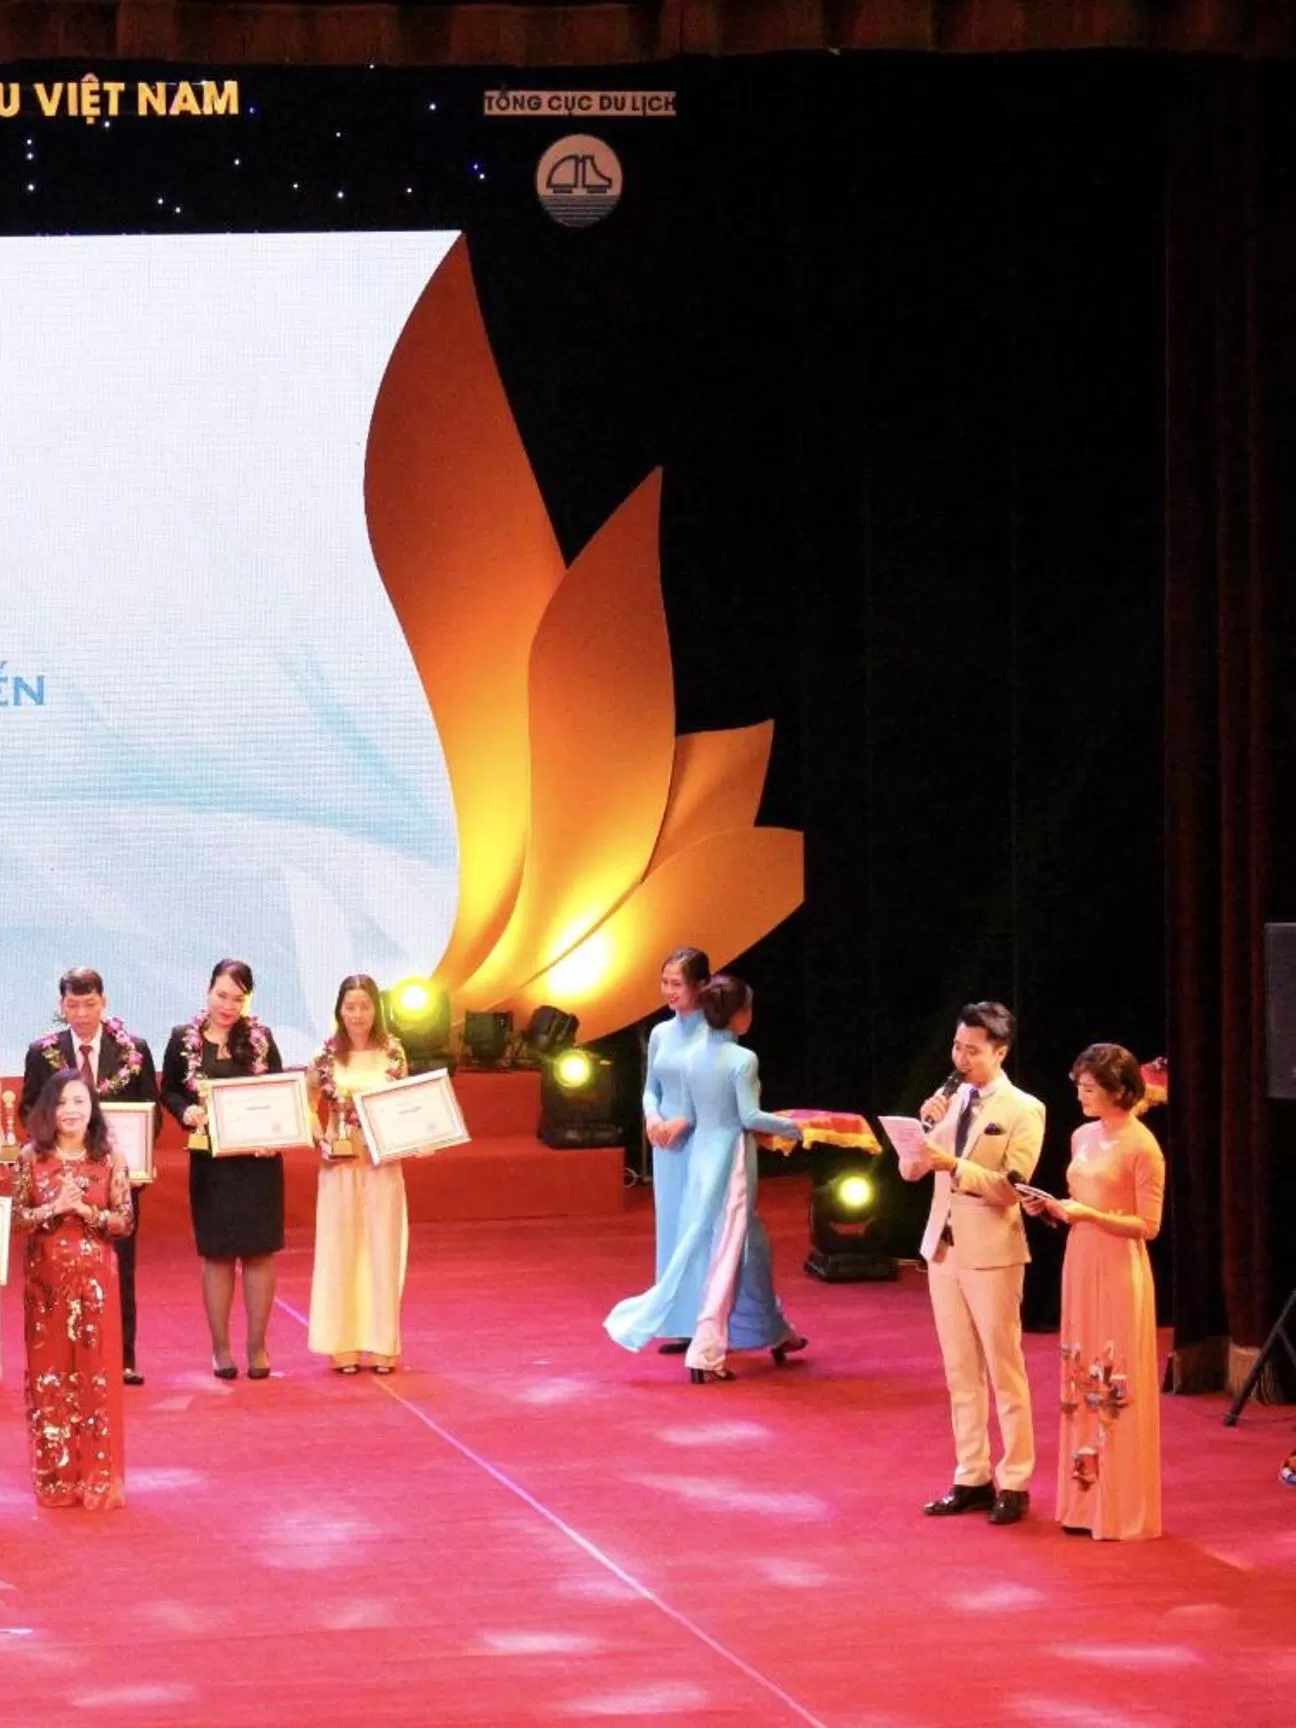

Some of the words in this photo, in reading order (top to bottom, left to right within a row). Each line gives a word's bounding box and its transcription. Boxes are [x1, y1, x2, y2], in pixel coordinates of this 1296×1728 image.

[34, 73, 126, 124] VIỆT
[137, 81, 239, 116] NAM
[599, 95, 626, 112] DU
[632, 95, 676, 116] LỊCH
